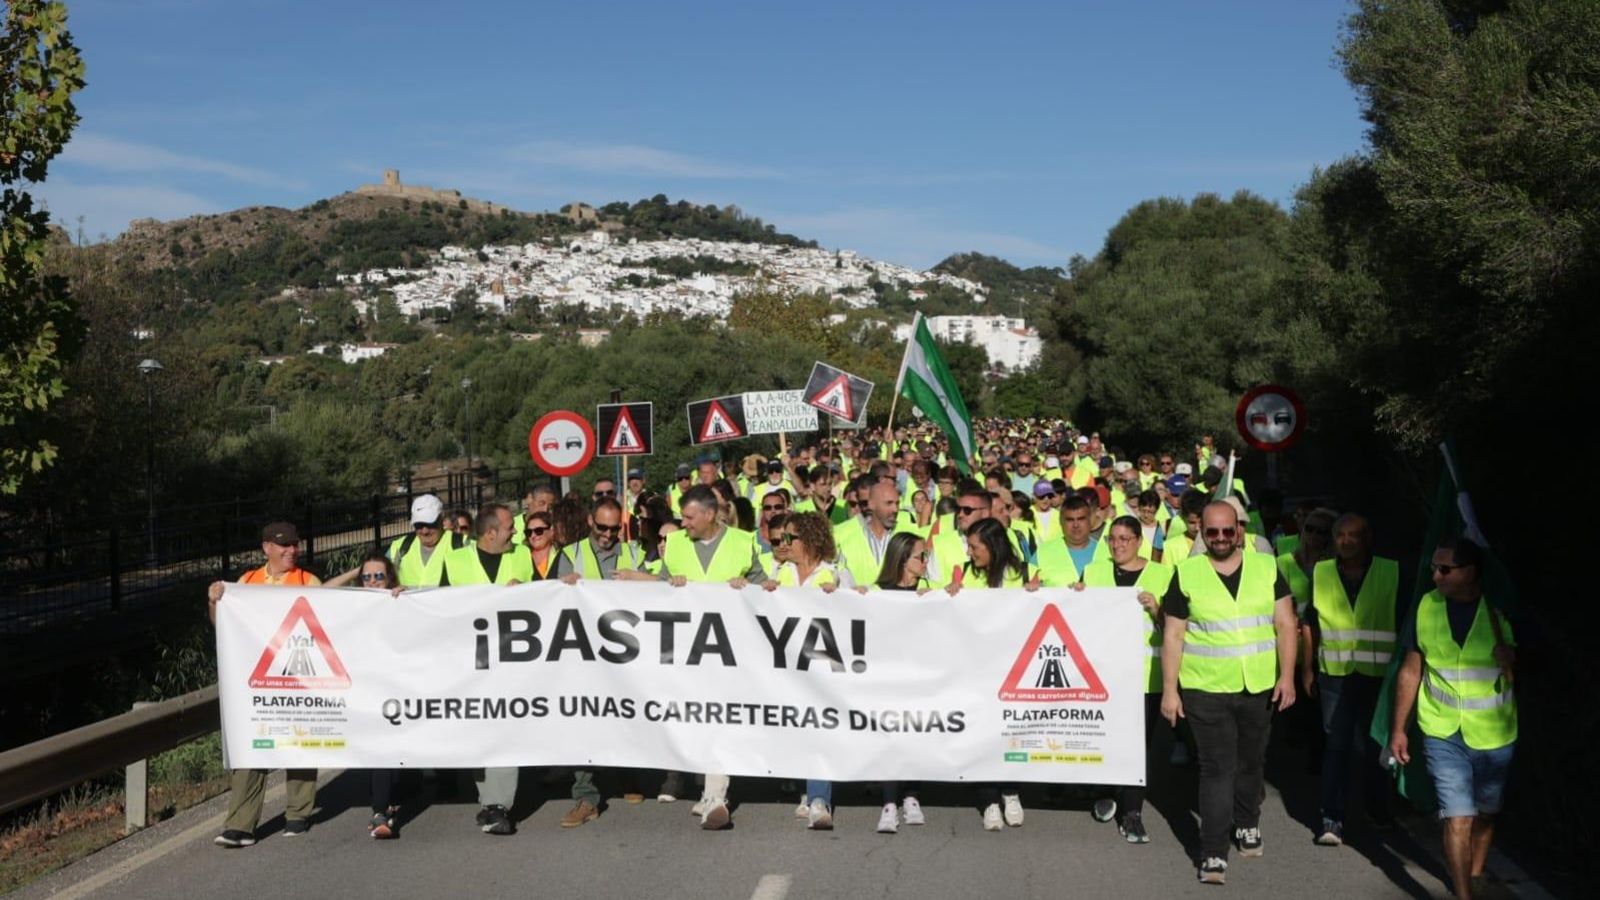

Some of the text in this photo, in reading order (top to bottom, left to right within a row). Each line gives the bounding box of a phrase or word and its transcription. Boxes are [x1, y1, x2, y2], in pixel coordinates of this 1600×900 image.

[473, 608, 868, 674] ¡BASTA YA!
[1038, 644, 1067, 660] ¡Ya!
[252, 695, 347, 708] PLATAFORMA
[382, 696, 966, 733] QUEREMOS UNAS CARRETERAS DIGNAS
[1002, 708, 1105, 721] PLATAFORMA
